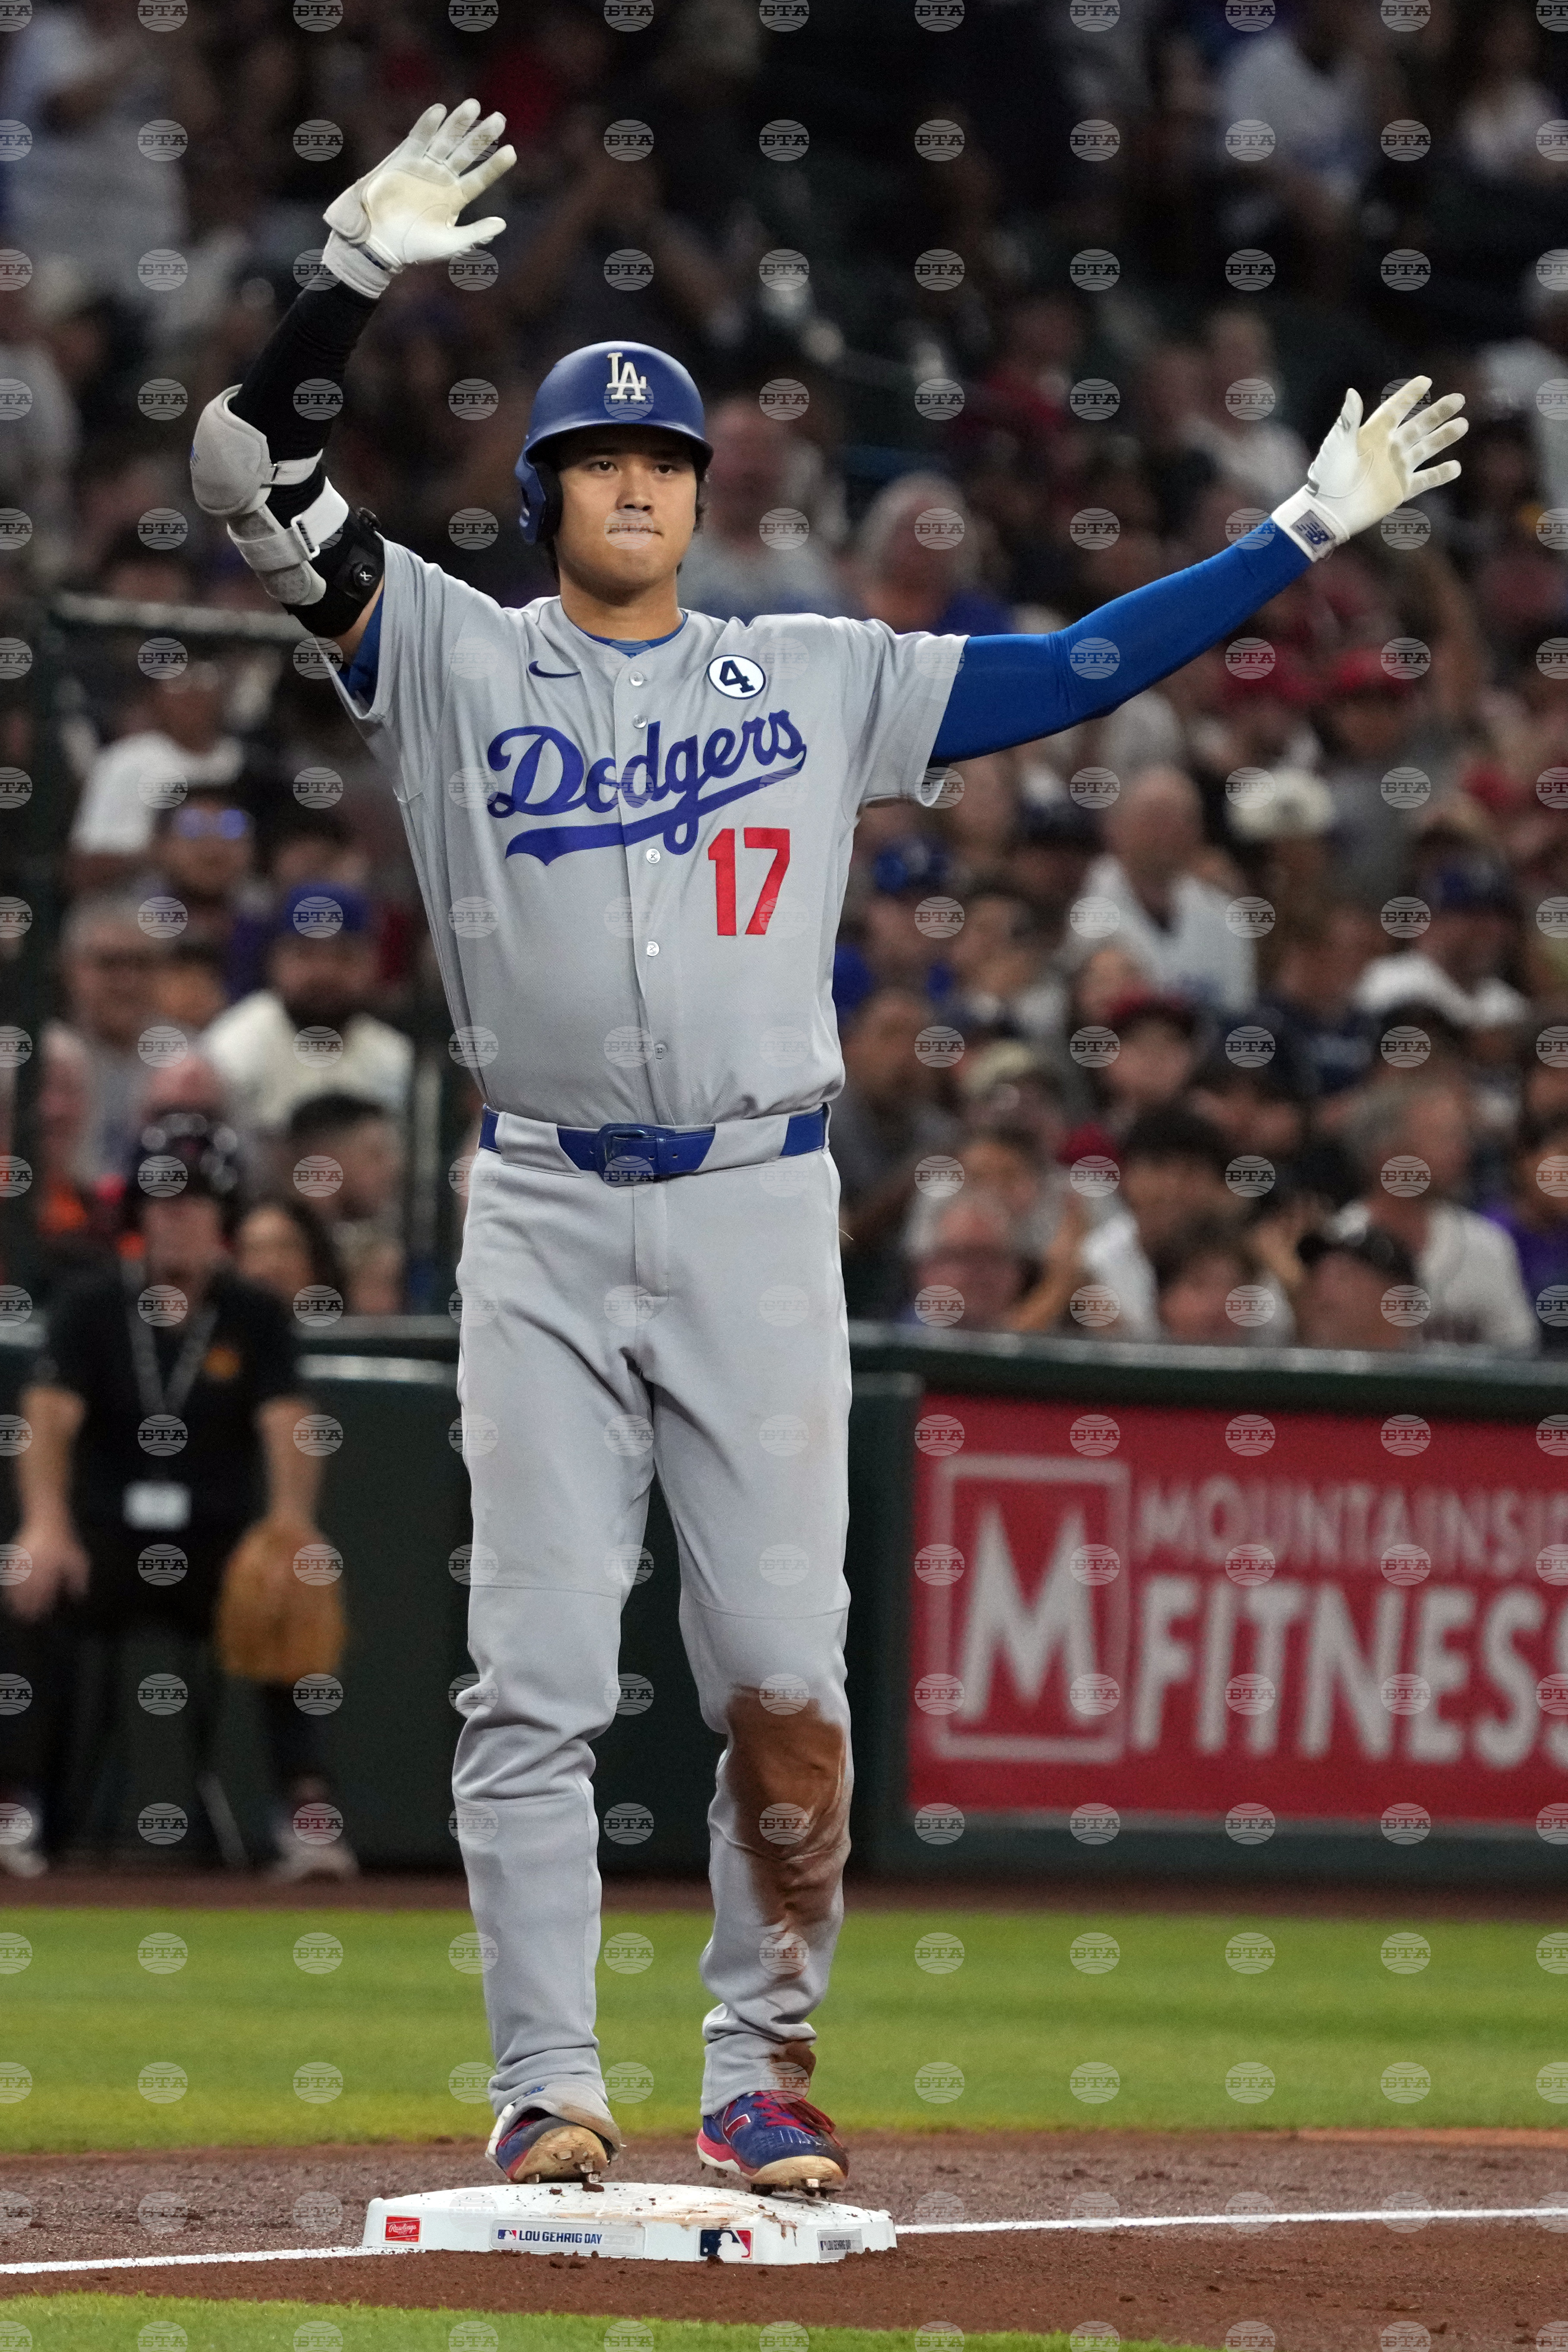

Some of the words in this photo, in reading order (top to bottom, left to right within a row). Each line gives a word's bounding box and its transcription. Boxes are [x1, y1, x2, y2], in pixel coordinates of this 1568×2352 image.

[607, 352, 647, 401] LA
[719, 660, 755, 693] 4
[487, 709, 807, 855] Dodgers
[708, 827, 790, 936] 17
[957, 1500, 1100, 1724] M
[1131, 1575, 1568, 1771] FITNES
[388, 2223, 417, 2234] Rawlings
[519, 2230, 540, 2241] LOU
[542, 2232, 583, 2244] GEHRIG
[584, 2233, 603, 2244] DAY
